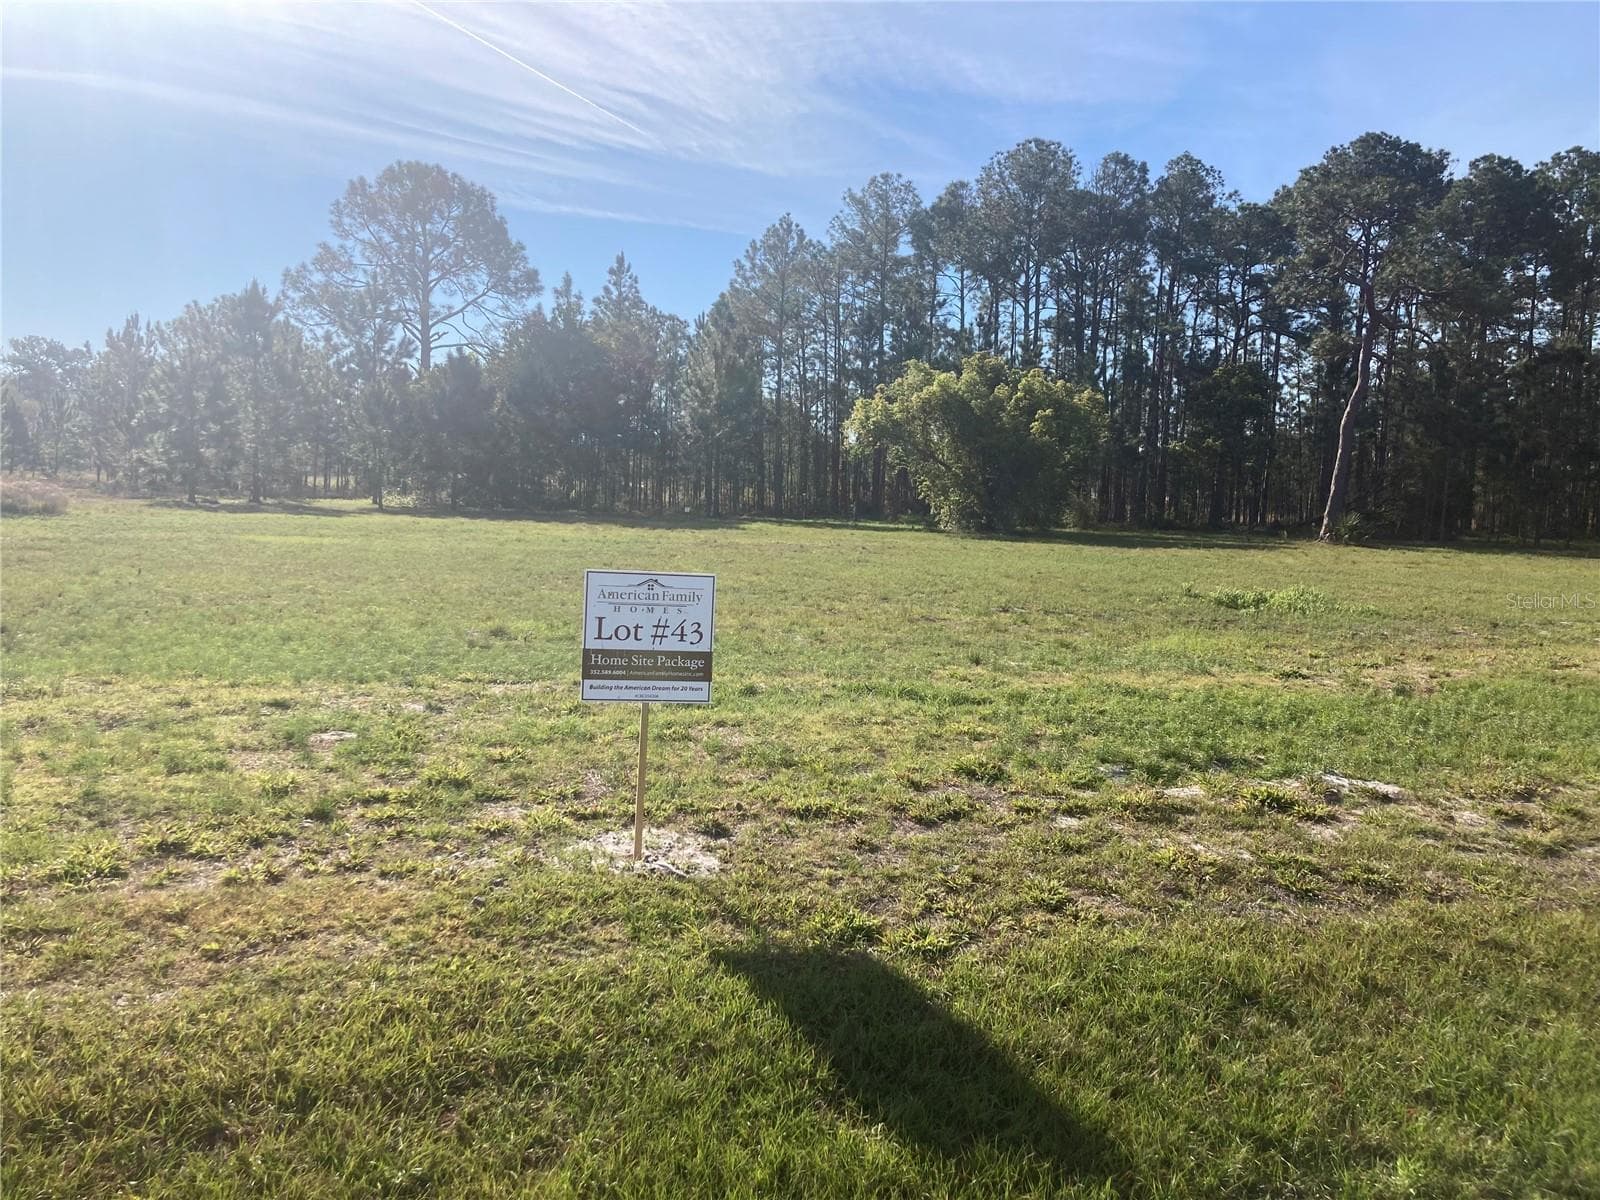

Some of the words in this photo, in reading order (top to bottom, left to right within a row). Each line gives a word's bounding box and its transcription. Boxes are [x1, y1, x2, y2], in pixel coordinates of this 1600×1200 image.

[597, 588, 659, 602] American
[662, 590, 703, 605] Family
[594, 616, 644, 641] Lot
[651, 616, 704, 645] #43
[590, 654, 628, 666] Home
[631, 655, 654, 666] Site
[656, 655, 705, 669] Package
